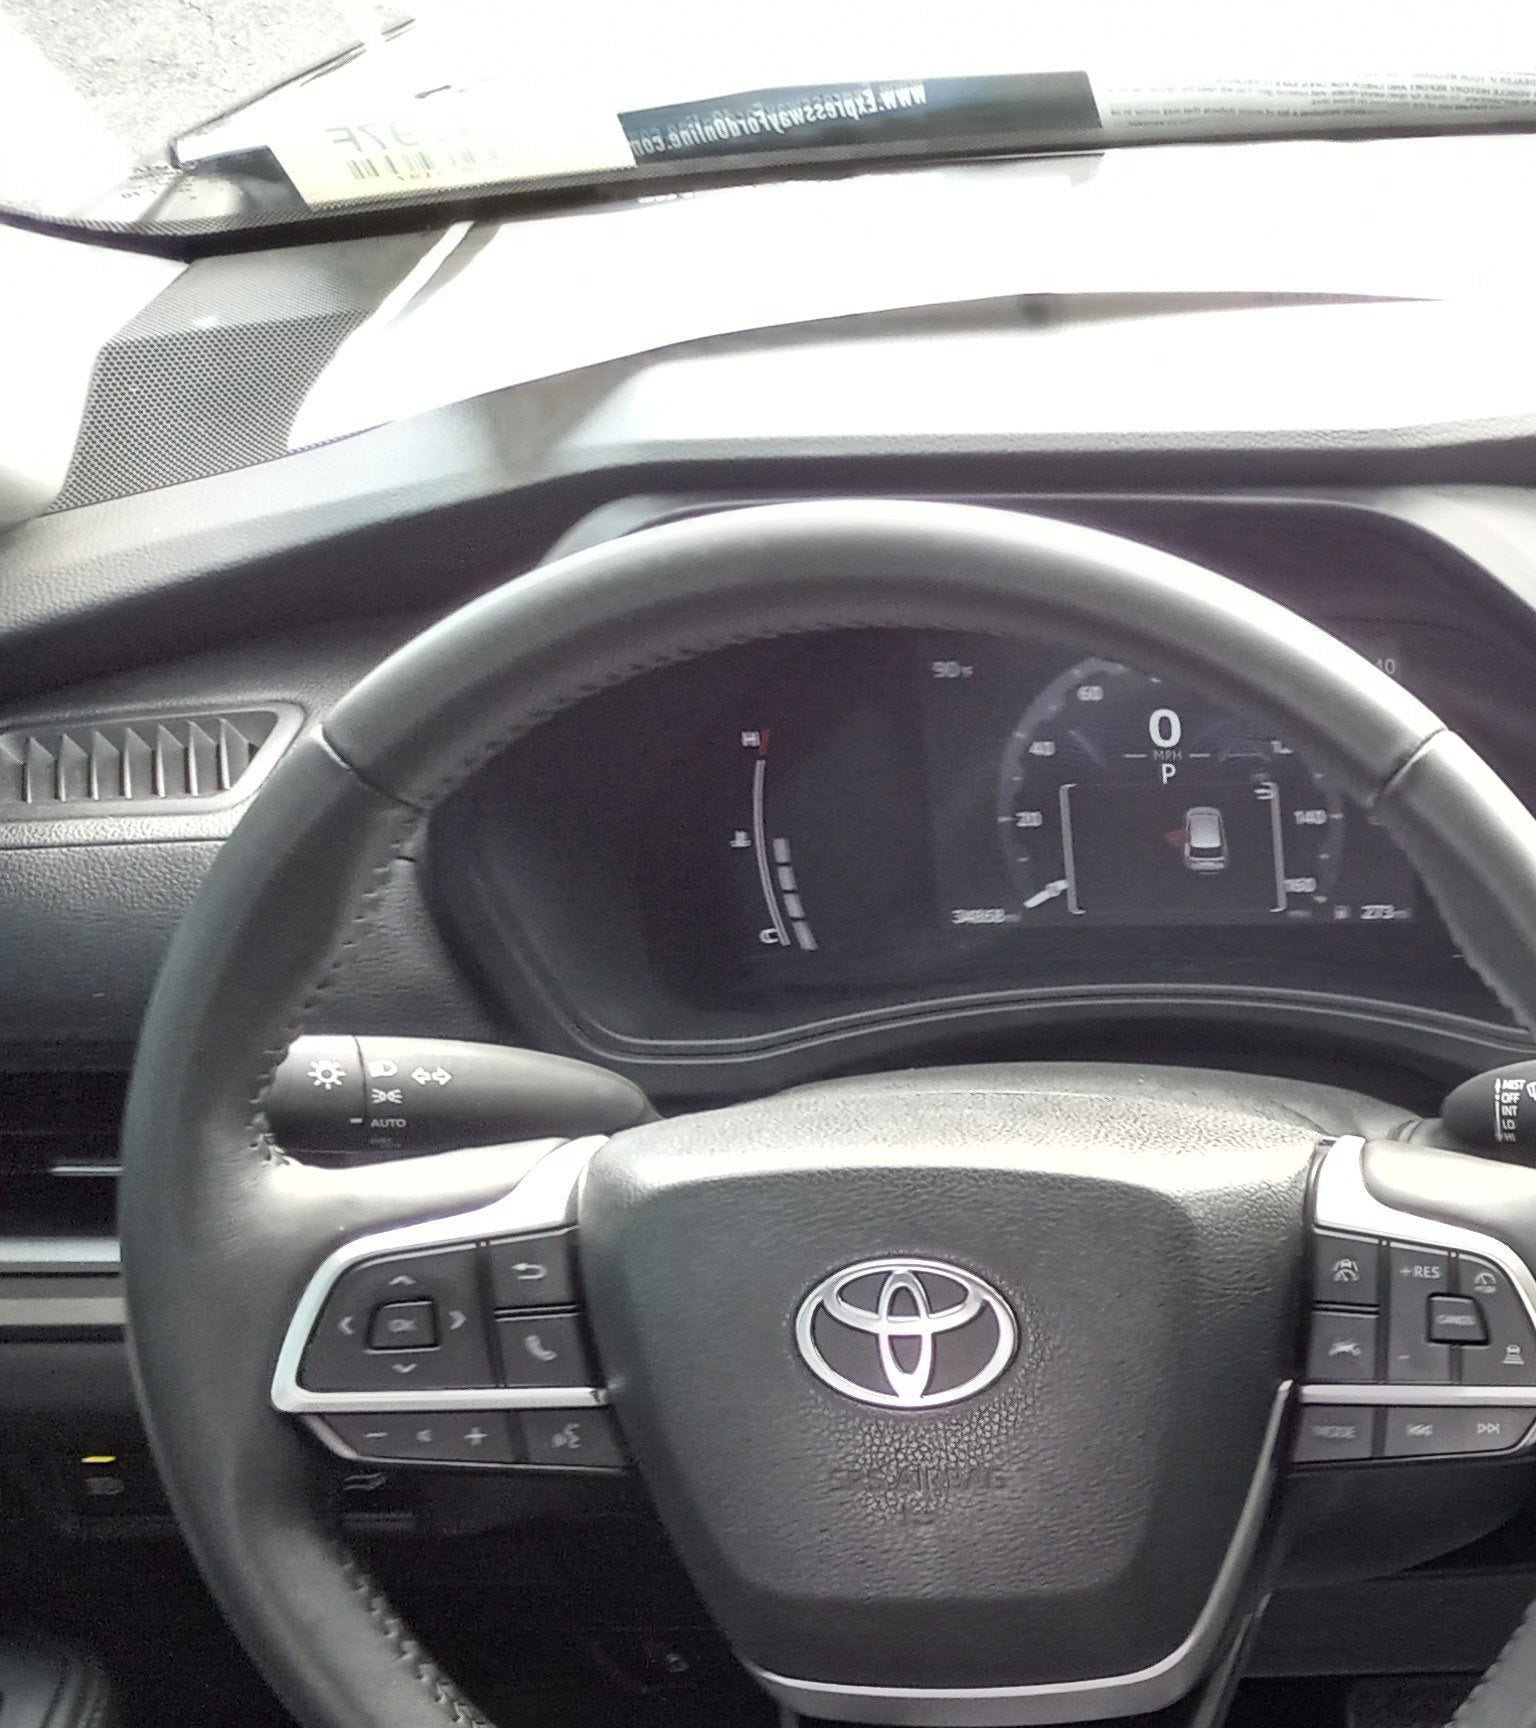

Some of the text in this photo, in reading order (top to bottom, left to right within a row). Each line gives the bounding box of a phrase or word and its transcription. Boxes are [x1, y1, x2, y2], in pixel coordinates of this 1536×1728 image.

[1148, 708, 1182, 748] 0
[1161, 763, 1177, 785] P
[1502, 1080, 1526, 1091] MIST
[1502, 1093, 1520, 1104] OFF
[1502, 1106, 1518, 1117] INT
[370, 1118, 407, 1128] AUTO
[1503, 1119, 1516, 1130] LO
